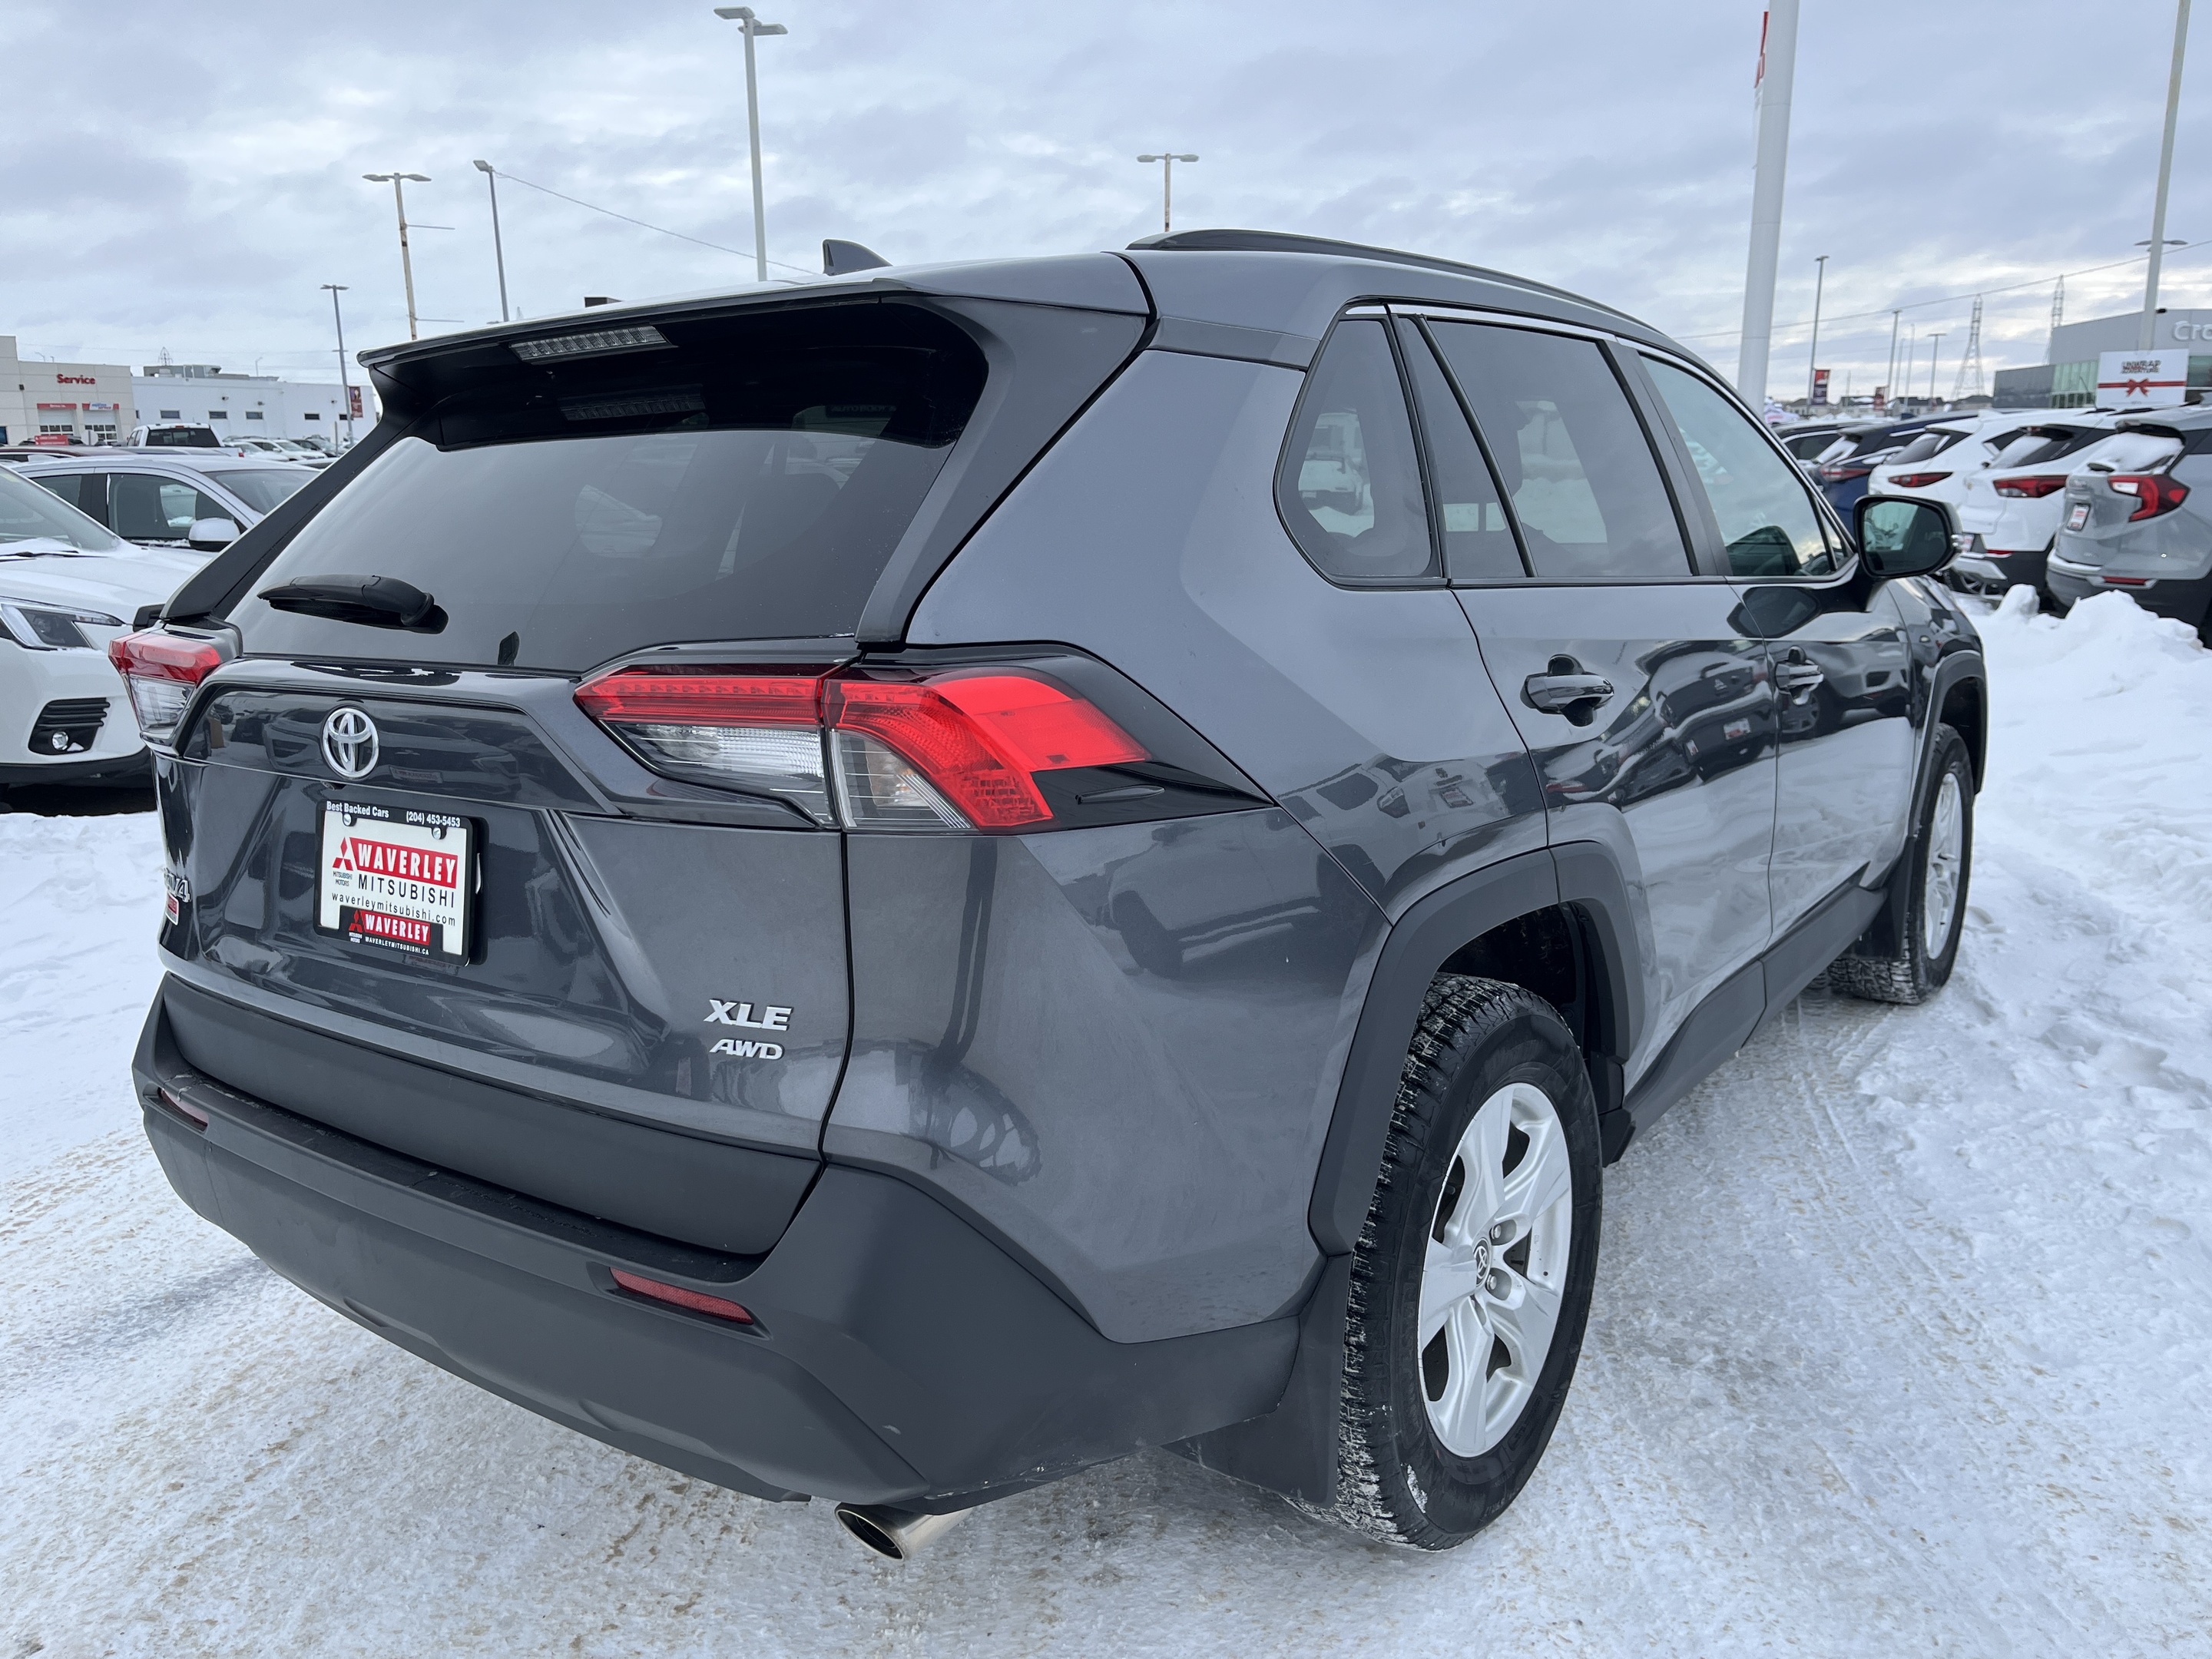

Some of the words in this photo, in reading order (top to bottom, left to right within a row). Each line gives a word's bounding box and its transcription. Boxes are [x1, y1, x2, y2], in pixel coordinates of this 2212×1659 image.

[57, 373, 95, 384] Service
[326, 800, 343, 812] Best
[344, 803, 370, 816] Backed
[373, 808, 389, 818] Cars
[406, 811, 425, 825] (204)
[426, 814, 460, 827] 453-5453
[333, 871, 353, 880] MITSUBISHI
[358, 843, 455, 883] WAVERLEY
[335, 879, 349, 887] MOTORS
[359, 874, 454, 908] MITSUBISHI
[332, 892, 455, 926] waverleymitsubishi.com
[365, 913, 429, 942] WAVERLEY
[365, 936, 429, 955] WAVERLEYMITSUBISHI.CA
[704, 998, 793, 1031] XLE
[709, 1038, 785, 1060] AWD
